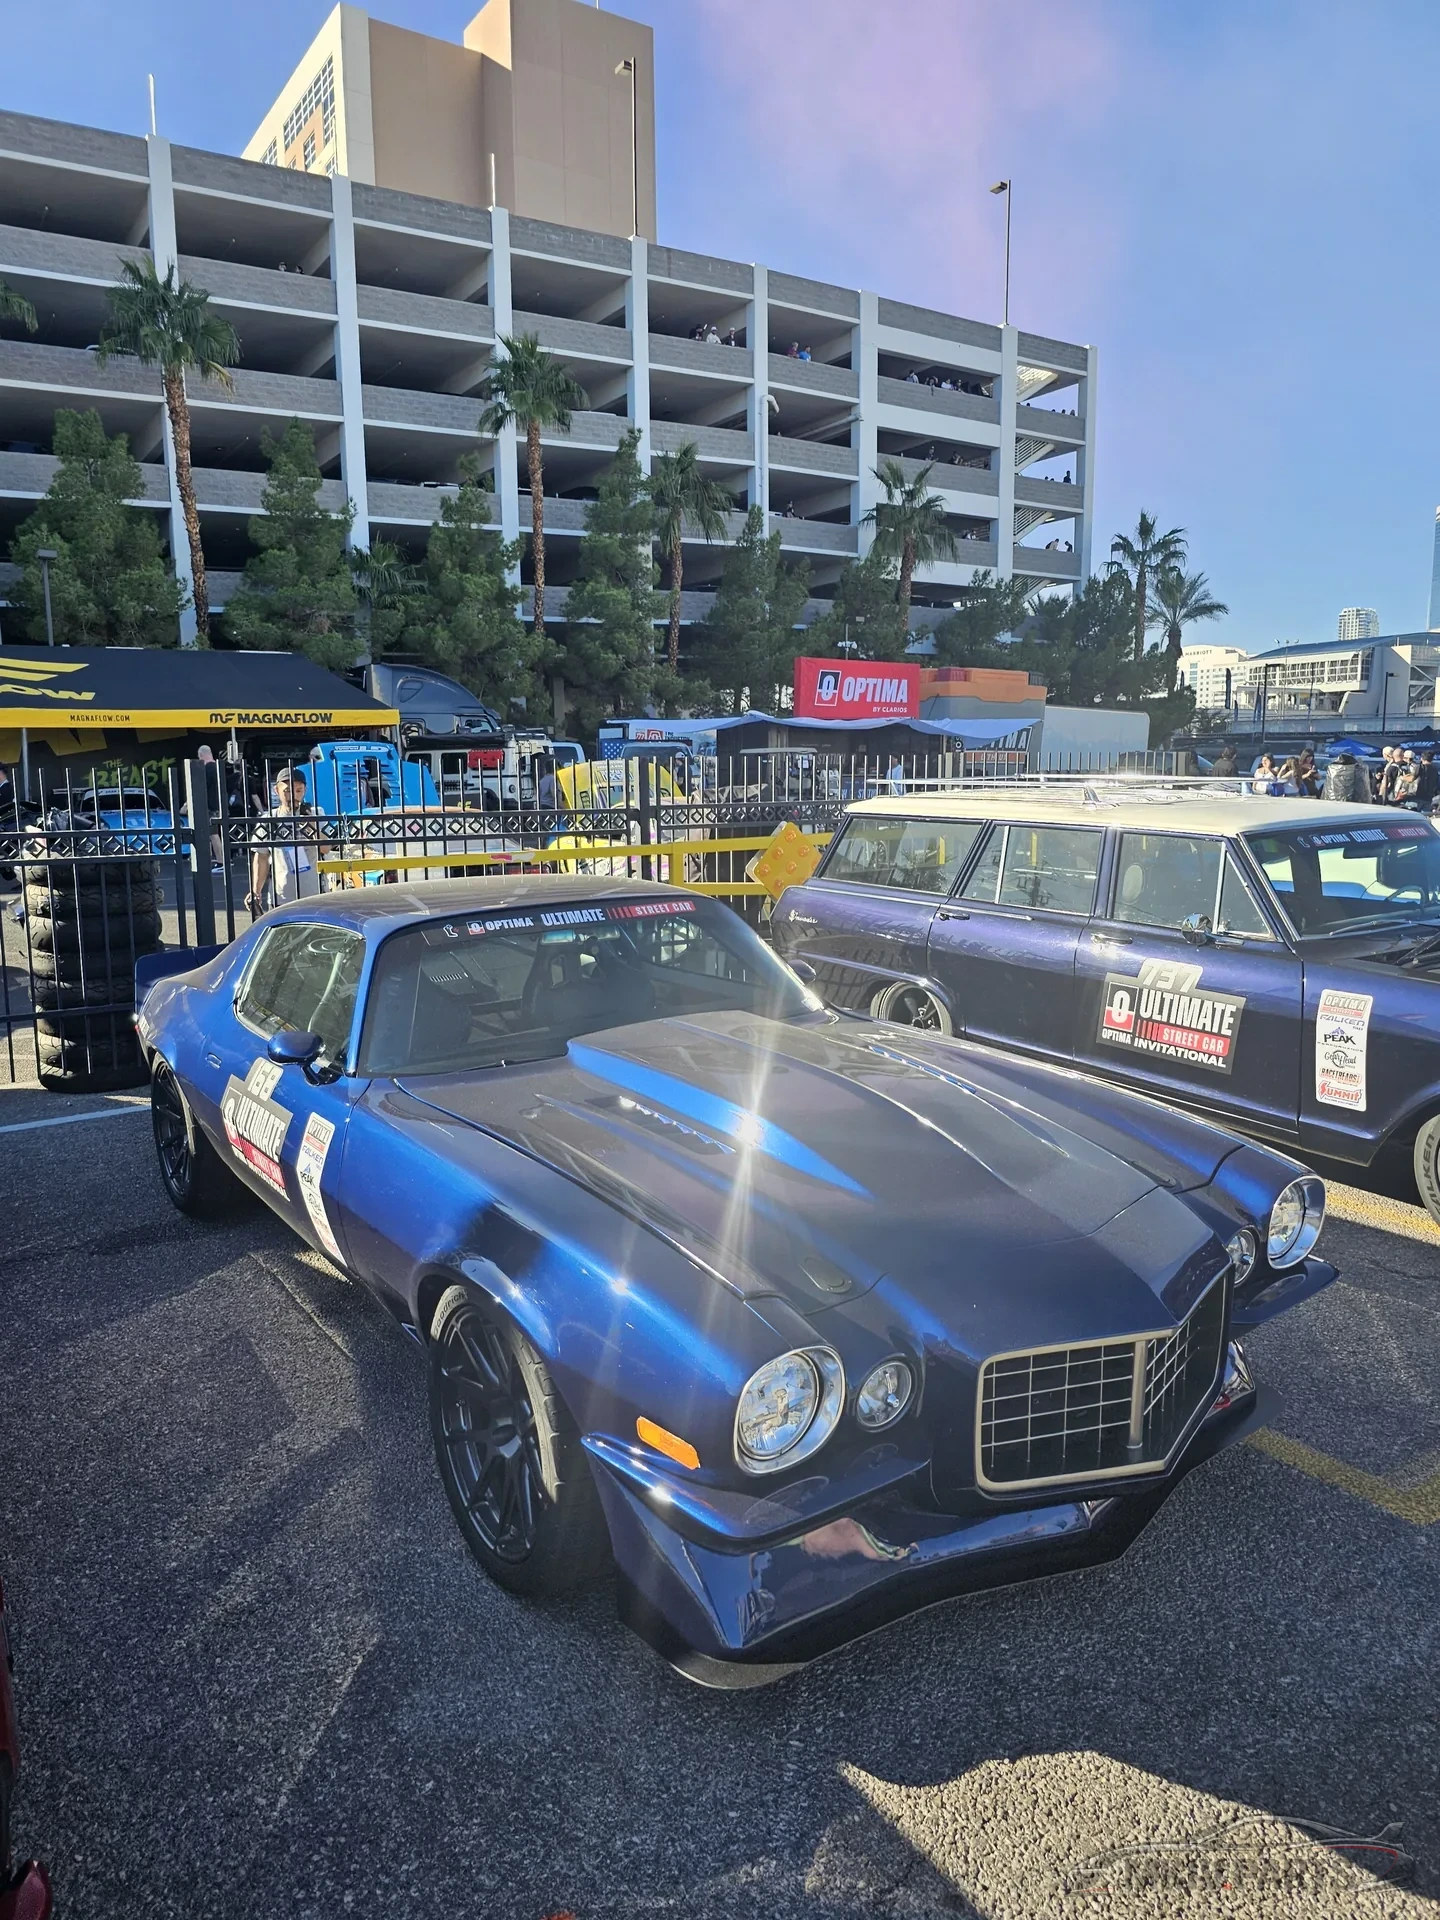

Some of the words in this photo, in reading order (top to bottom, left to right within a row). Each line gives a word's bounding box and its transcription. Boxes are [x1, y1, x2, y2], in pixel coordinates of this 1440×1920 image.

[842, 676, 908, 703] OPTIMA
[70, 714, 131, 722] MAGNAFLOW.COM
[238, 712, 333, 724] MAGNAFLOW
[102, 758, 123, 768] THE
[485, 917, 533, 931] OPTIMA
[540, 908, 606, 927] ULTIMATE
[635, 904, 670, 916] STREET
[672, 902, 692, 912] CAR
[1139, 988, 1237, 1036] ULTIMATE
[1324, 995, 1367, 1011] OPTIMA
[1320, 1014, 1365, 1026] FALKEN
[1102, 1027, 1132, 1045] OPTIMA
[1162, 1028, 1199, 1048] STREET
[1202, 1038, 1225, 1054] CAR
[1324, 1034, 1356, 1045] PEAK
[1134, 1037, 1227, 1068] INVITATIONAL
[235, 1095, 286, 1163] ULTIMATE
[302, 1145, 324, 1164] FALKEN
